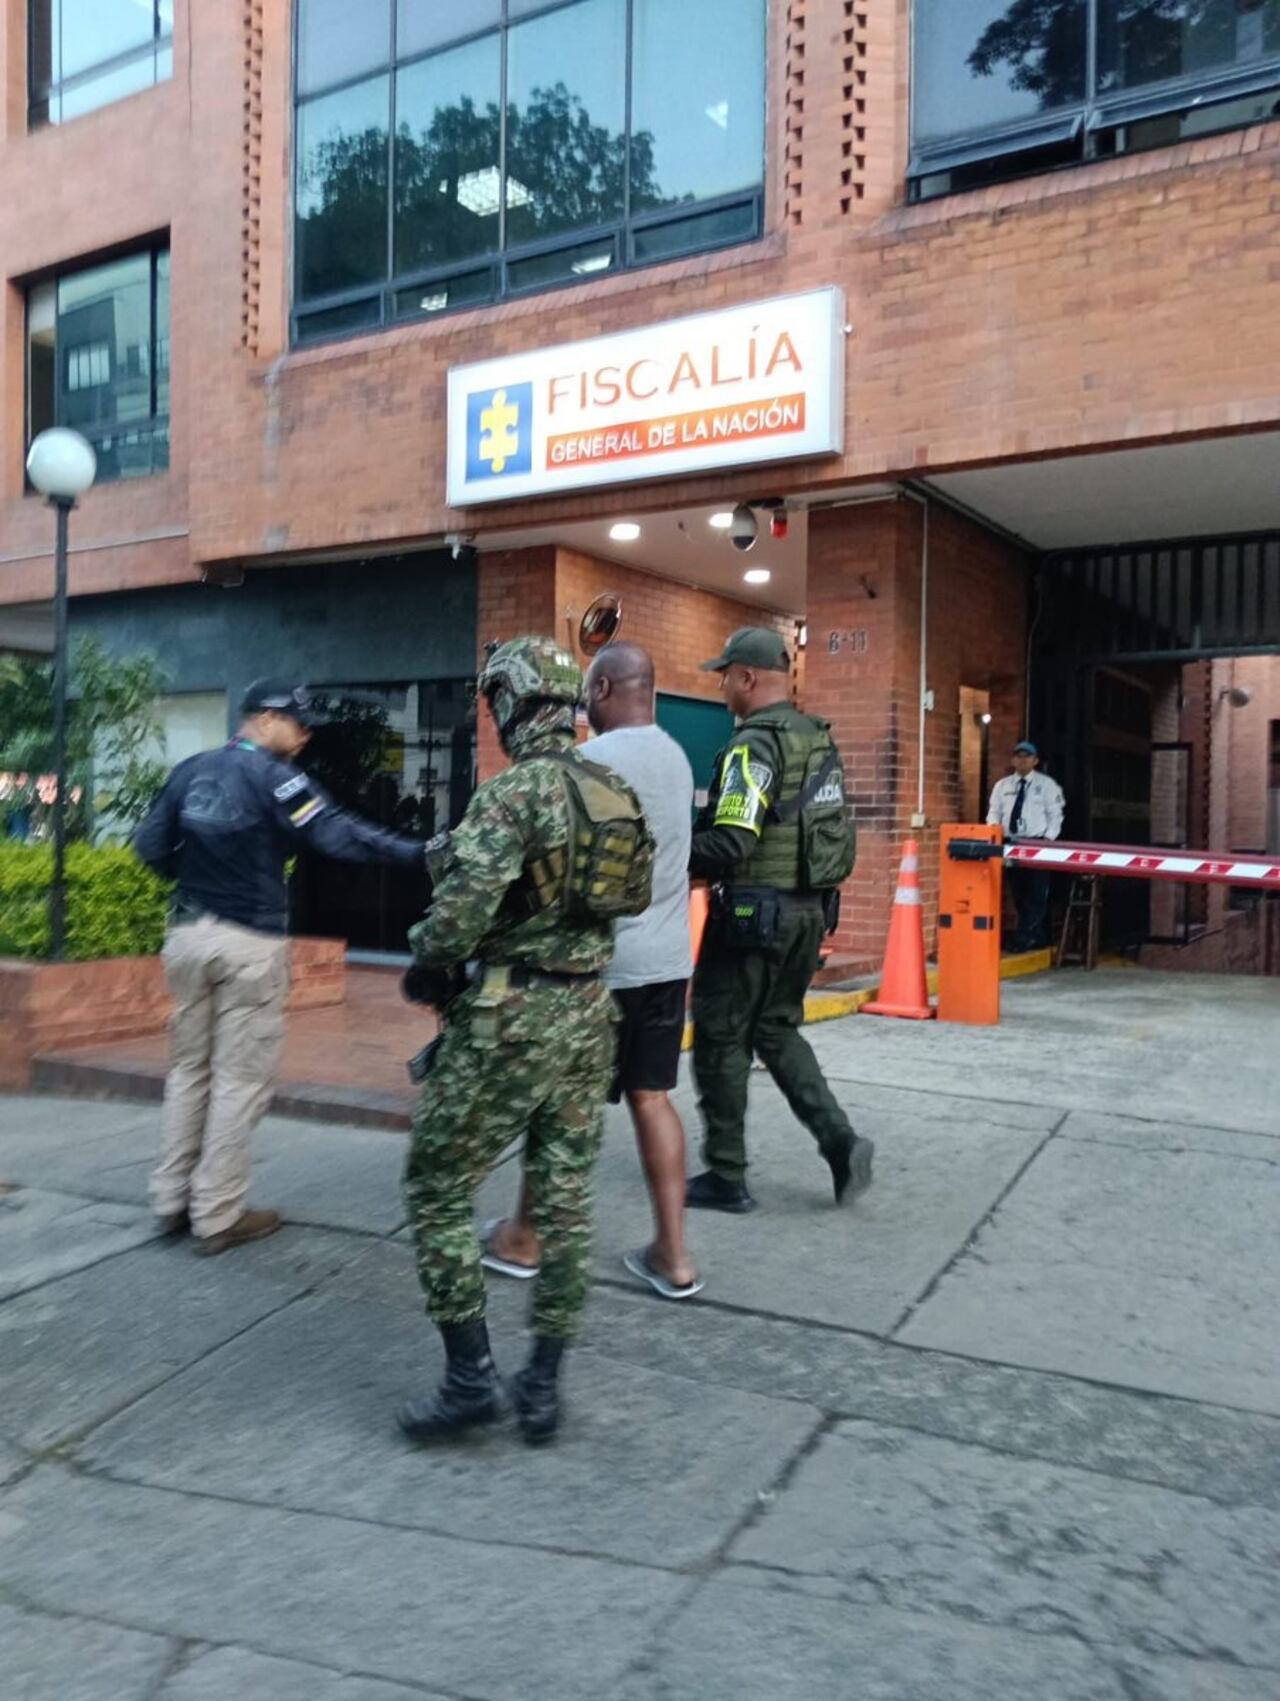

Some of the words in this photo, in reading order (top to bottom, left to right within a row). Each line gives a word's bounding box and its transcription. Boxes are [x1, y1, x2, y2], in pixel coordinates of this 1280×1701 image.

[548, 325, 802, 415] FISCALÍA
[551, 429, 643, 464] GENERAL
[647, 421, 675, 449] DE
[681, 416, 705, 442] LA
[712, 397, 799, 439] NACIÓN
